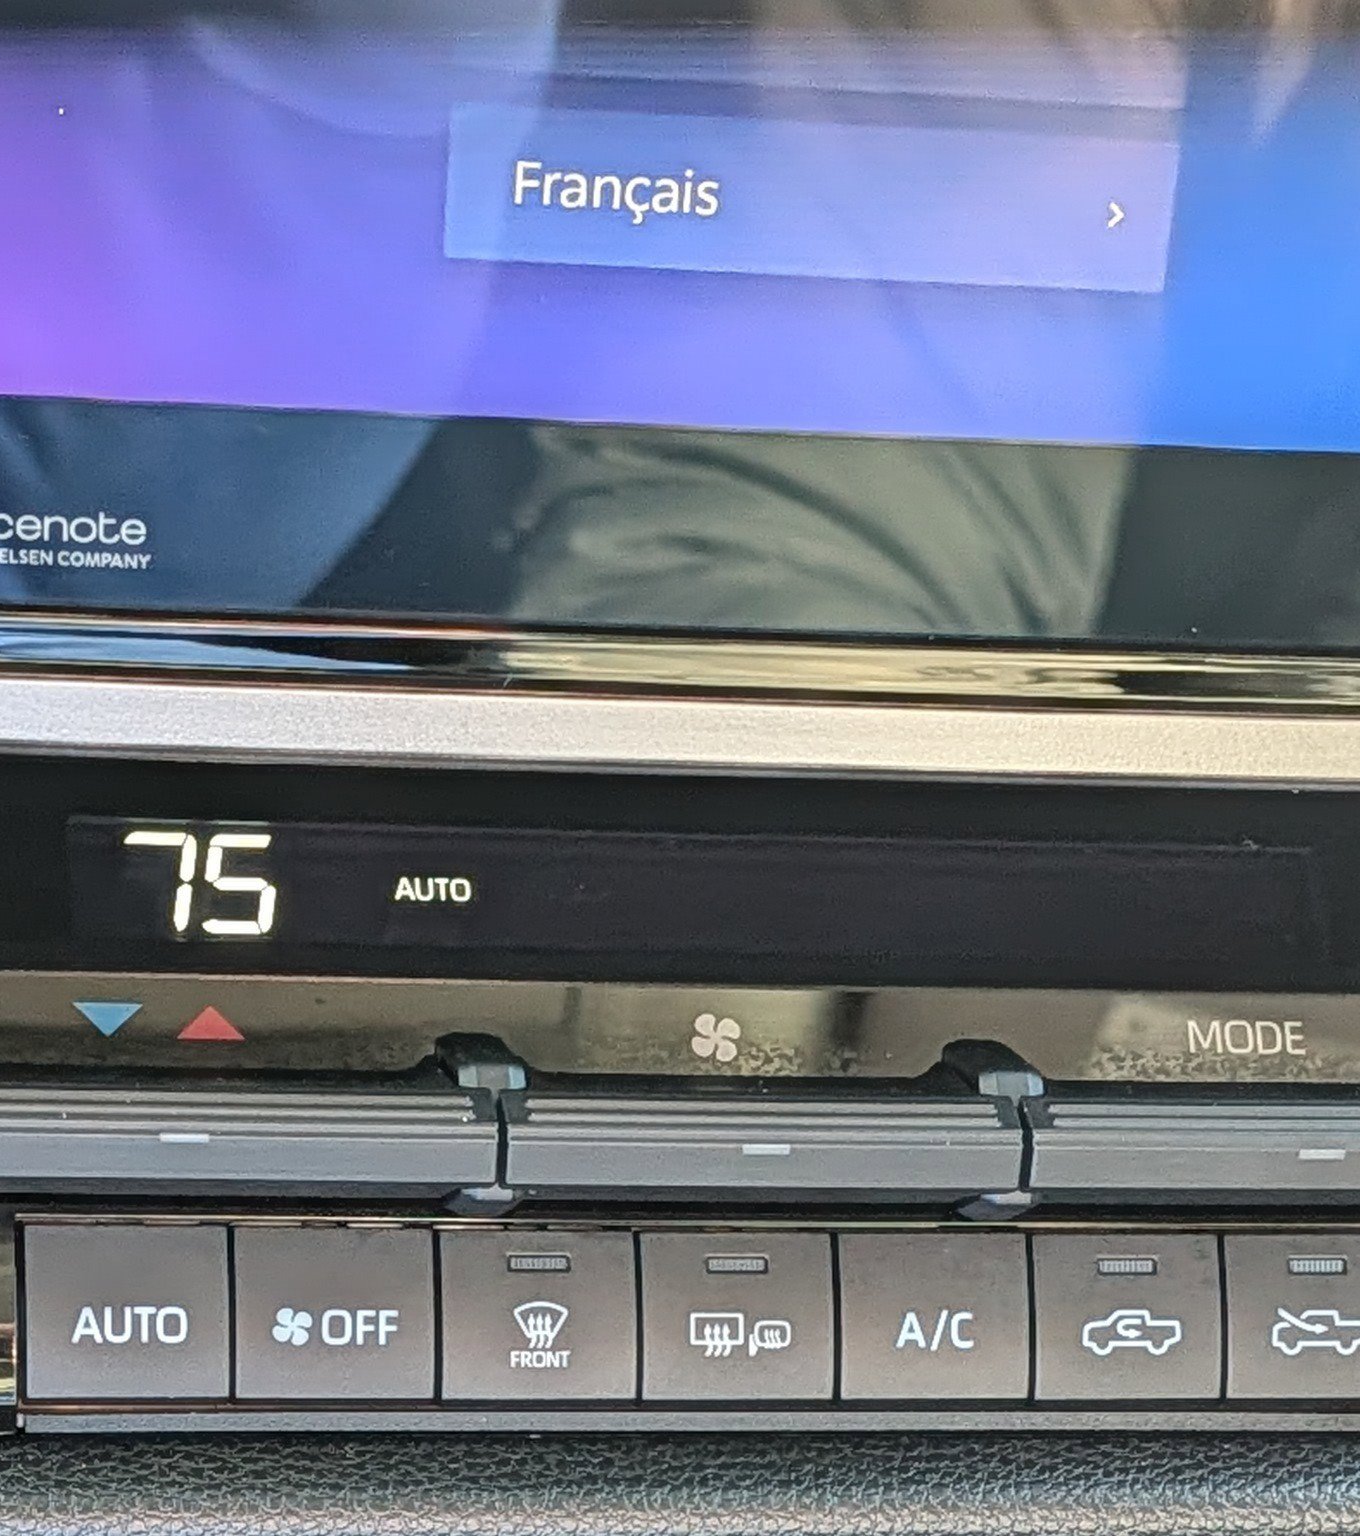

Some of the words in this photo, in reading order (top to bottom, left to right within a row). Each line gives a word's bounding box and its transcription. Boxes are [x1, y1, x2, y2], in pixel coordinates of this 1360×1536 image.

[512, 160, 720, 224] Français
[57, 551, 151, 570] COMPANY
[123, 830, 277, 935] 75
[394, 876, 472, 902] AUTO
[1187, 1019, 1306, 1055] MODE
[71, 1305, 188, 1345] AUTO
[321, 1309, 400, 1346] OFF
[895, 1309, 974, 1352] A/C
[509, 1349, 571, 1369] FRONT
